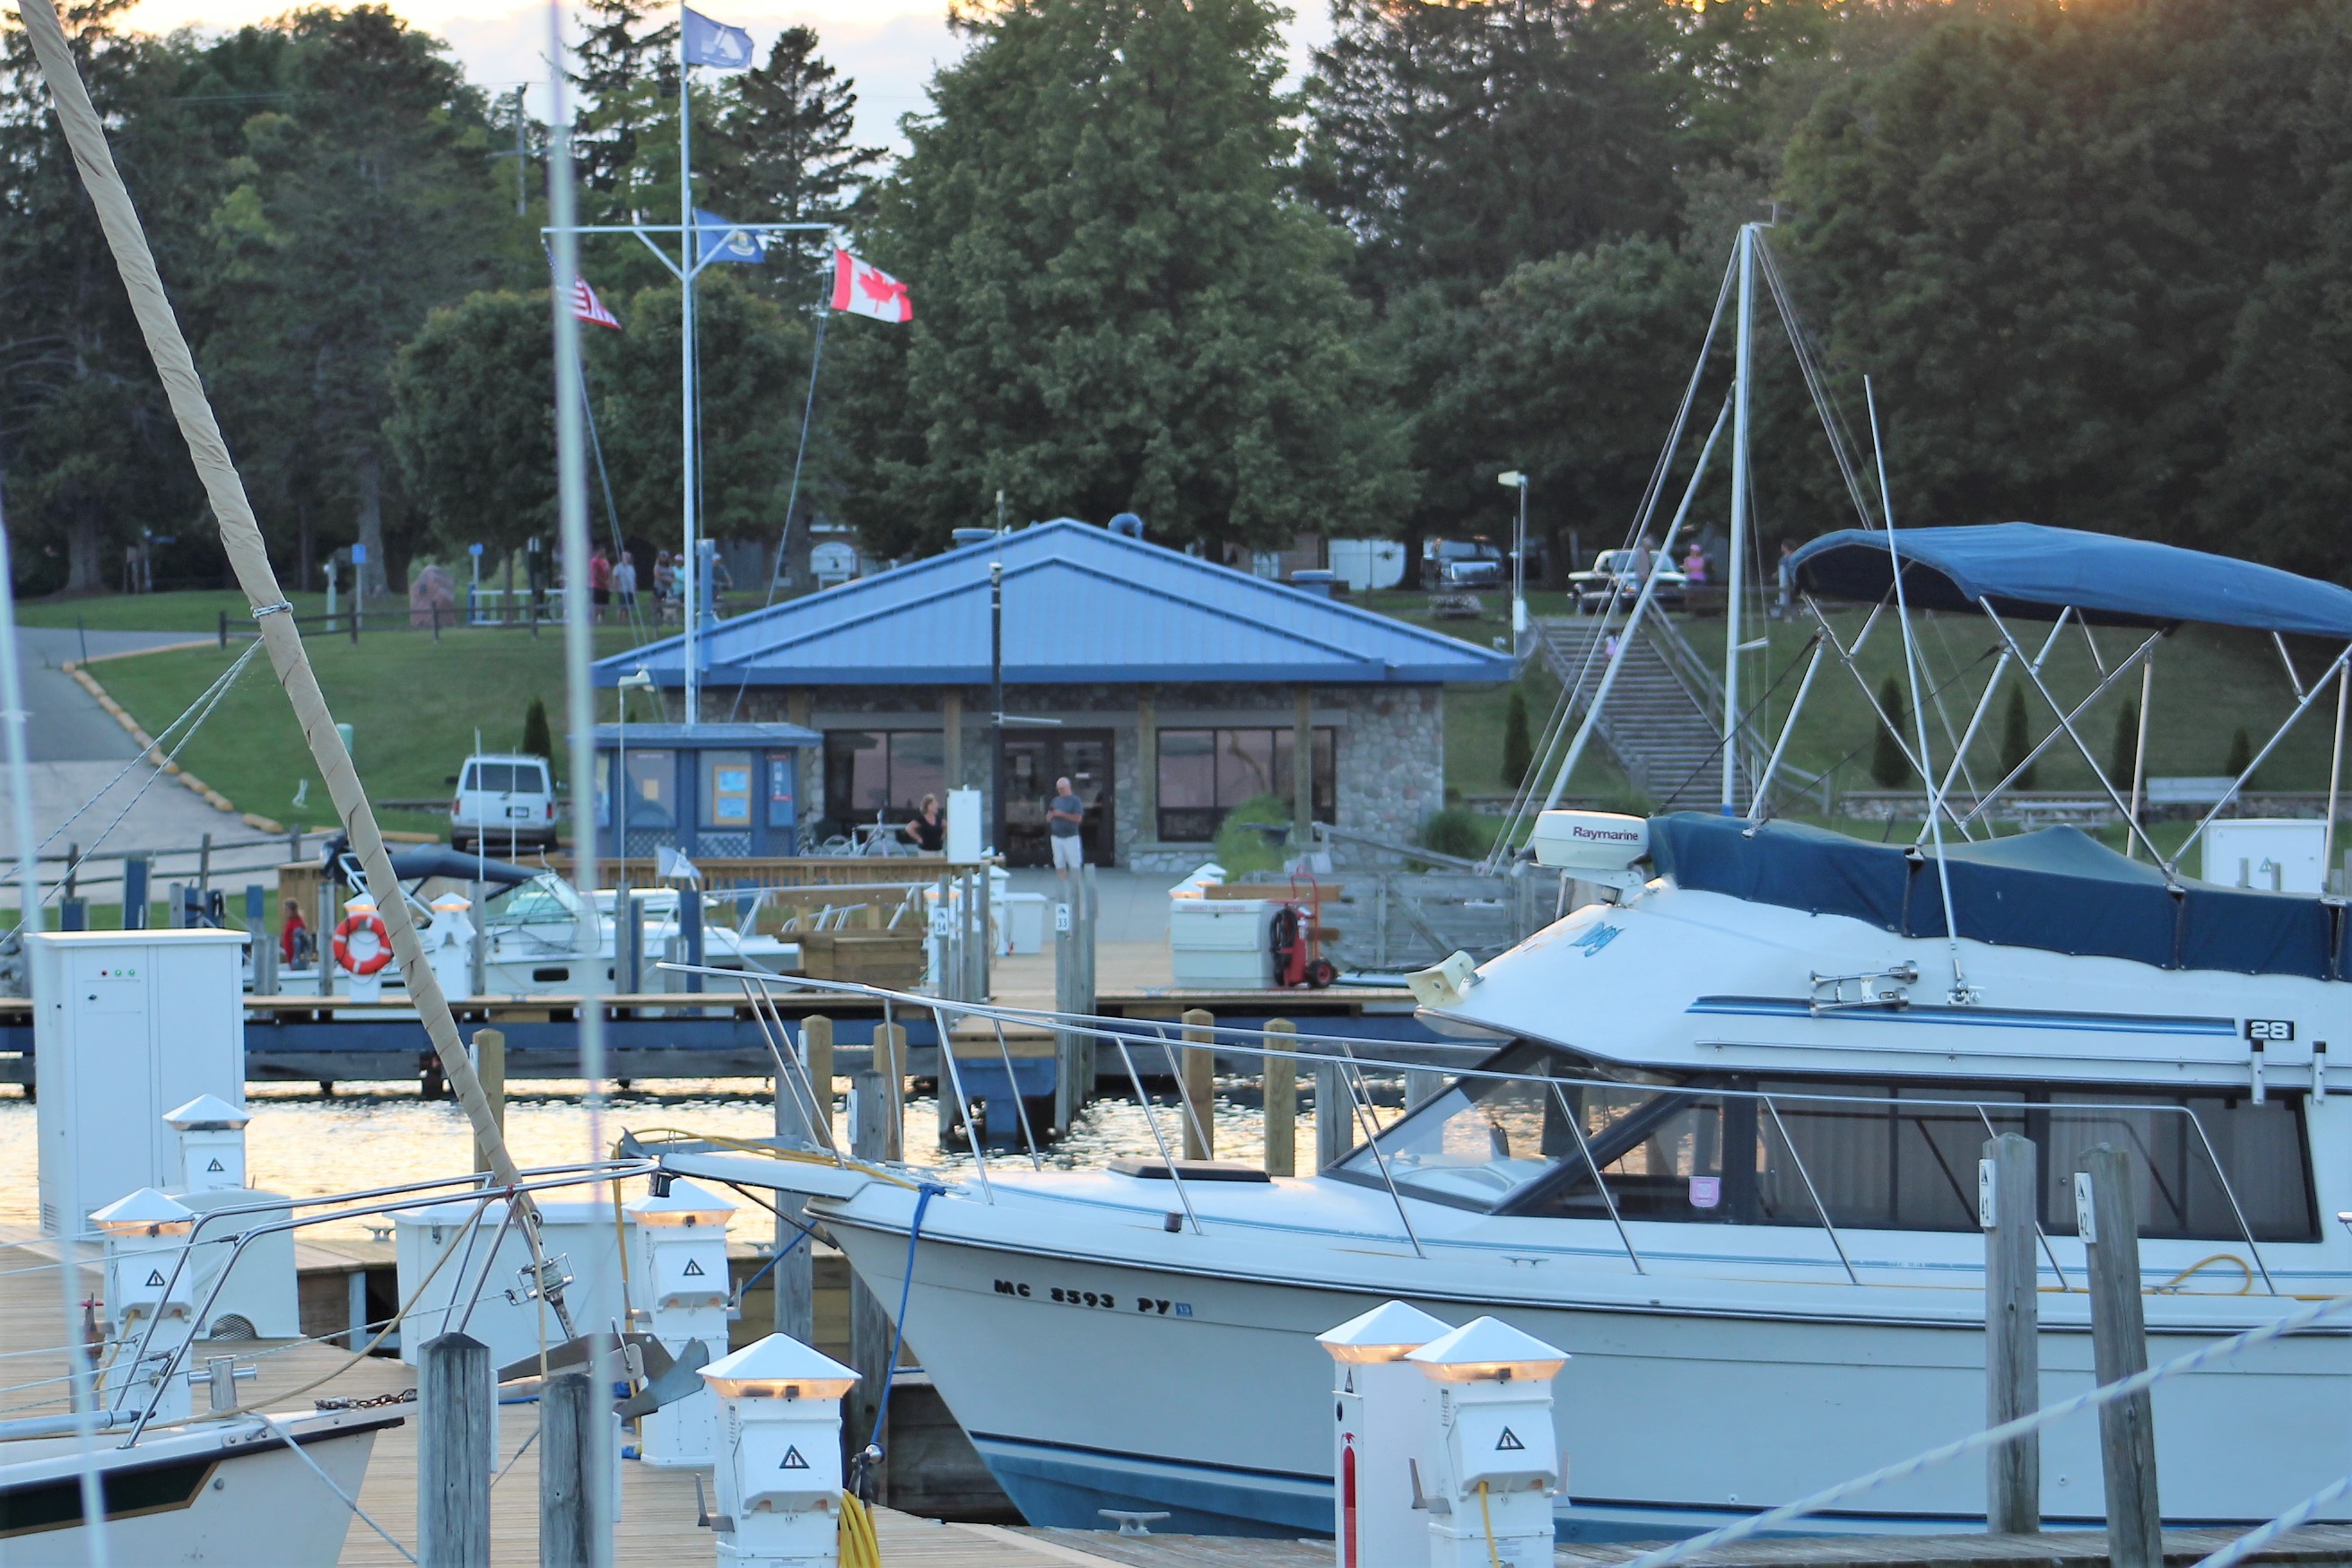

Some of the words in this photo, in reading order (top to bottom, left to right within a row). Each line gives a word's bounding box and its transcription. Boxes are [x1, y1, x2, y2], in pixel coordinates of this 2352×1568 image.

[1572, 826, 1638, 841] Raymarine
[2250, 1021, 2288, 1039] 28
[1981, 1197, 1990, 1220] 41
[2079, 1212, 2089, 1236] 42
[994, 1279, 1031, 1297] MC
[1050, 1287, 1115, 1309] 8593
[1137, 1297, 1171, 1314] PY
